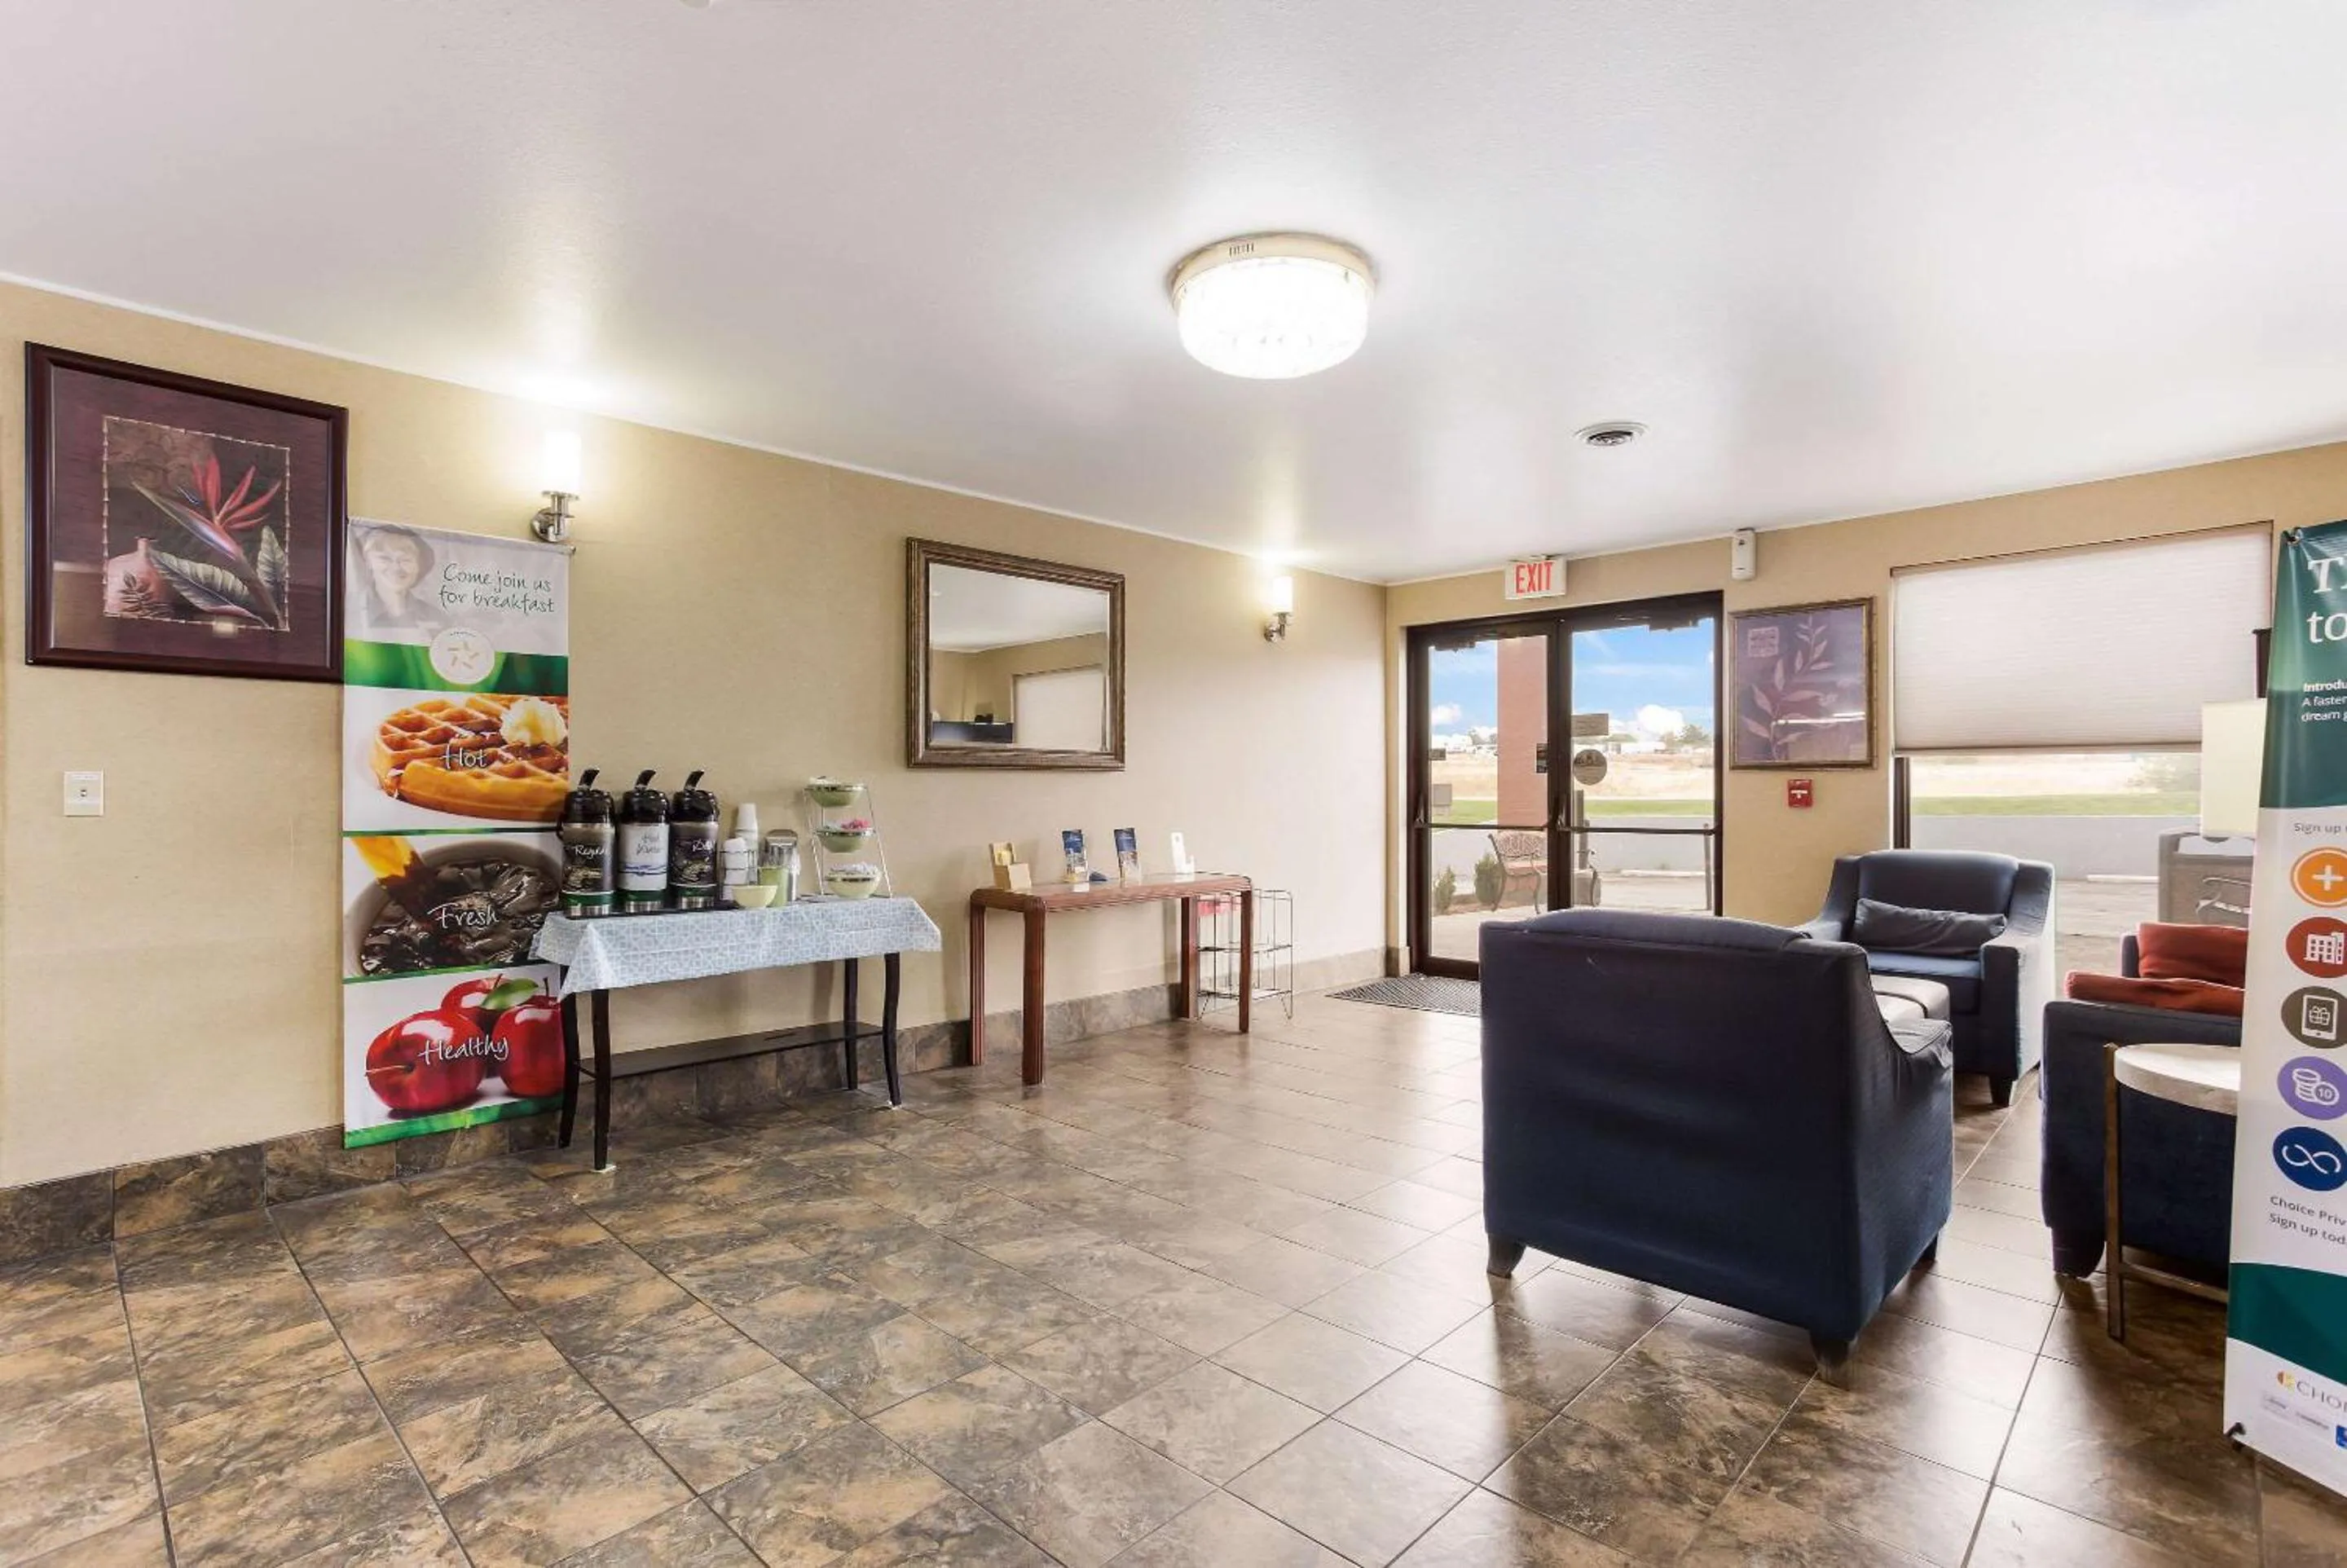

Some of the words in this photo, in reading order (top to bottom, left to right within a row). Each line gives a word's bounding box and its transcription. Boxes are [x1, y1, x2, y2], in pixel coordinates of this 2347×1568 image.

[443, 563, 491, 584] Come
[494, 570, 528, 593] join
[533, 578, 552, 592] us
[1515, 562, 1553, 594] EXIT
[2307, 556, 2347, 594] T
[438, 584, 465, 610] for
[473, 588, 555, 615] breakfast
[2301, 697, 2312, 707] A
[2301, 711, 2340, 722] dream
[440, 743, 488, 769] Hot
[2294, 822, 2321, 835] Sign
[2324, 825, 2341, 835] up
[427, 902, 500, 929] Fresh
[417, 1033, 509, 1066] Healthy
[2269, 1212, 2297, 1230] Sign
[2301, 1224, 2318, 1237] up
[2270, 1196, 2315, 1217] Choice
[2318, 1209, 2347, 1226] Priv
